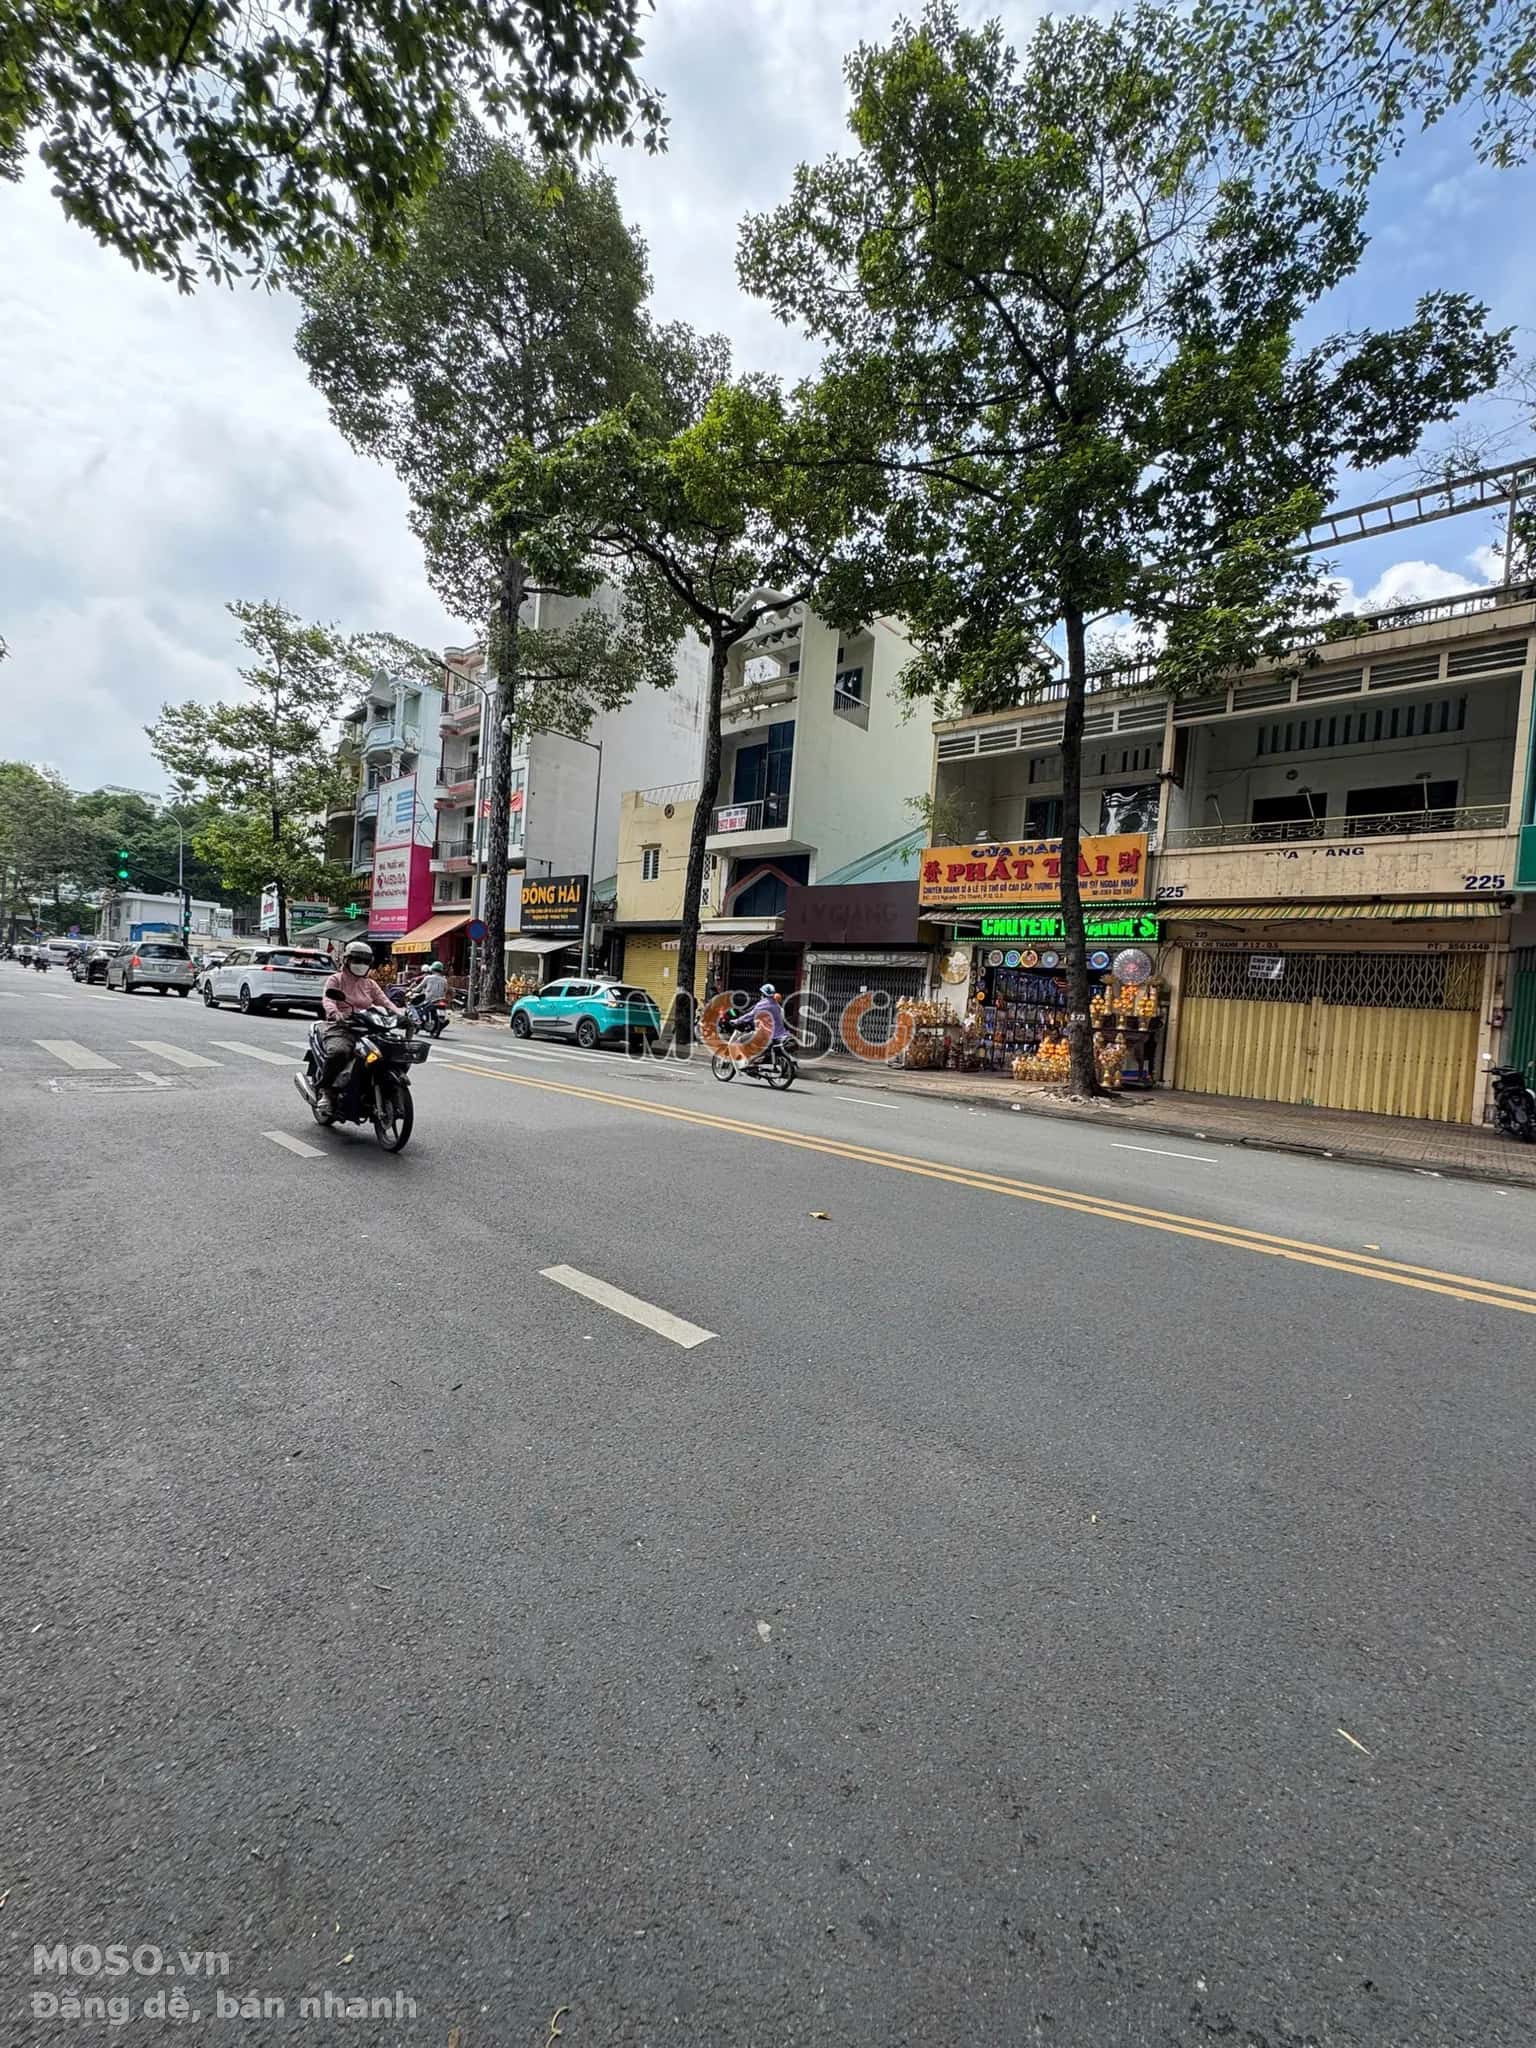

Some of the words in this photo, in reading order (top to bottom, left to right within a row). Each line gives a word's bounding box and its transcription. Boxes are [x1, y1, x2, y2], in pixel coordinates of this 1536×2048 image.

[947, 855, 1034, 883] PHÁT
[1465, 874, 1506, 890] 225
[1157, 886, 1184, 899] 225
